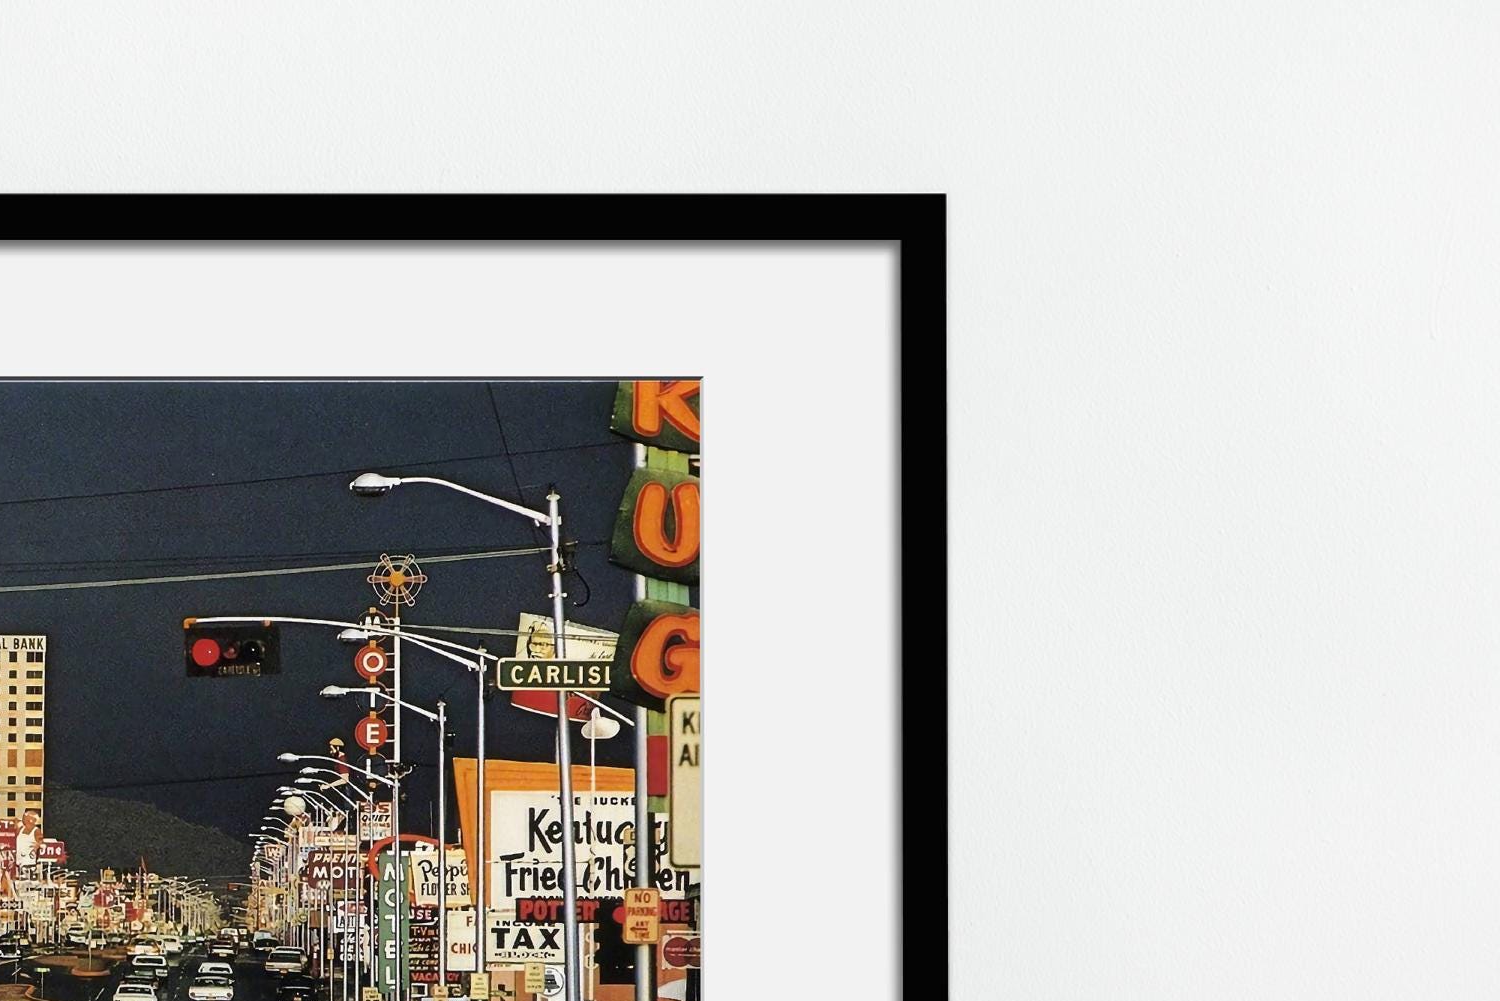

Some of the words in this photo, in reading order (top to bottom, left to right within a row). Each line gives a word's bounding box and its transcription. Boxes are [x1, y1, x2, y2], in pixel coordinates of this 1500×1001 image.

[13, 638, 44, 650] BANK
[510, 665, 611, 685] CARLISL
[312, 866, 357, 879] MOT
[421, 882, 457, 896] FLOER
[634, 892, 651, 903] NO
[627, 906, 657, 916] PARKING
[383, 863, 405, 985] MOTEL
[490, 927, 561, 950] TAX
[411, 972, 460, 982] VACACY
